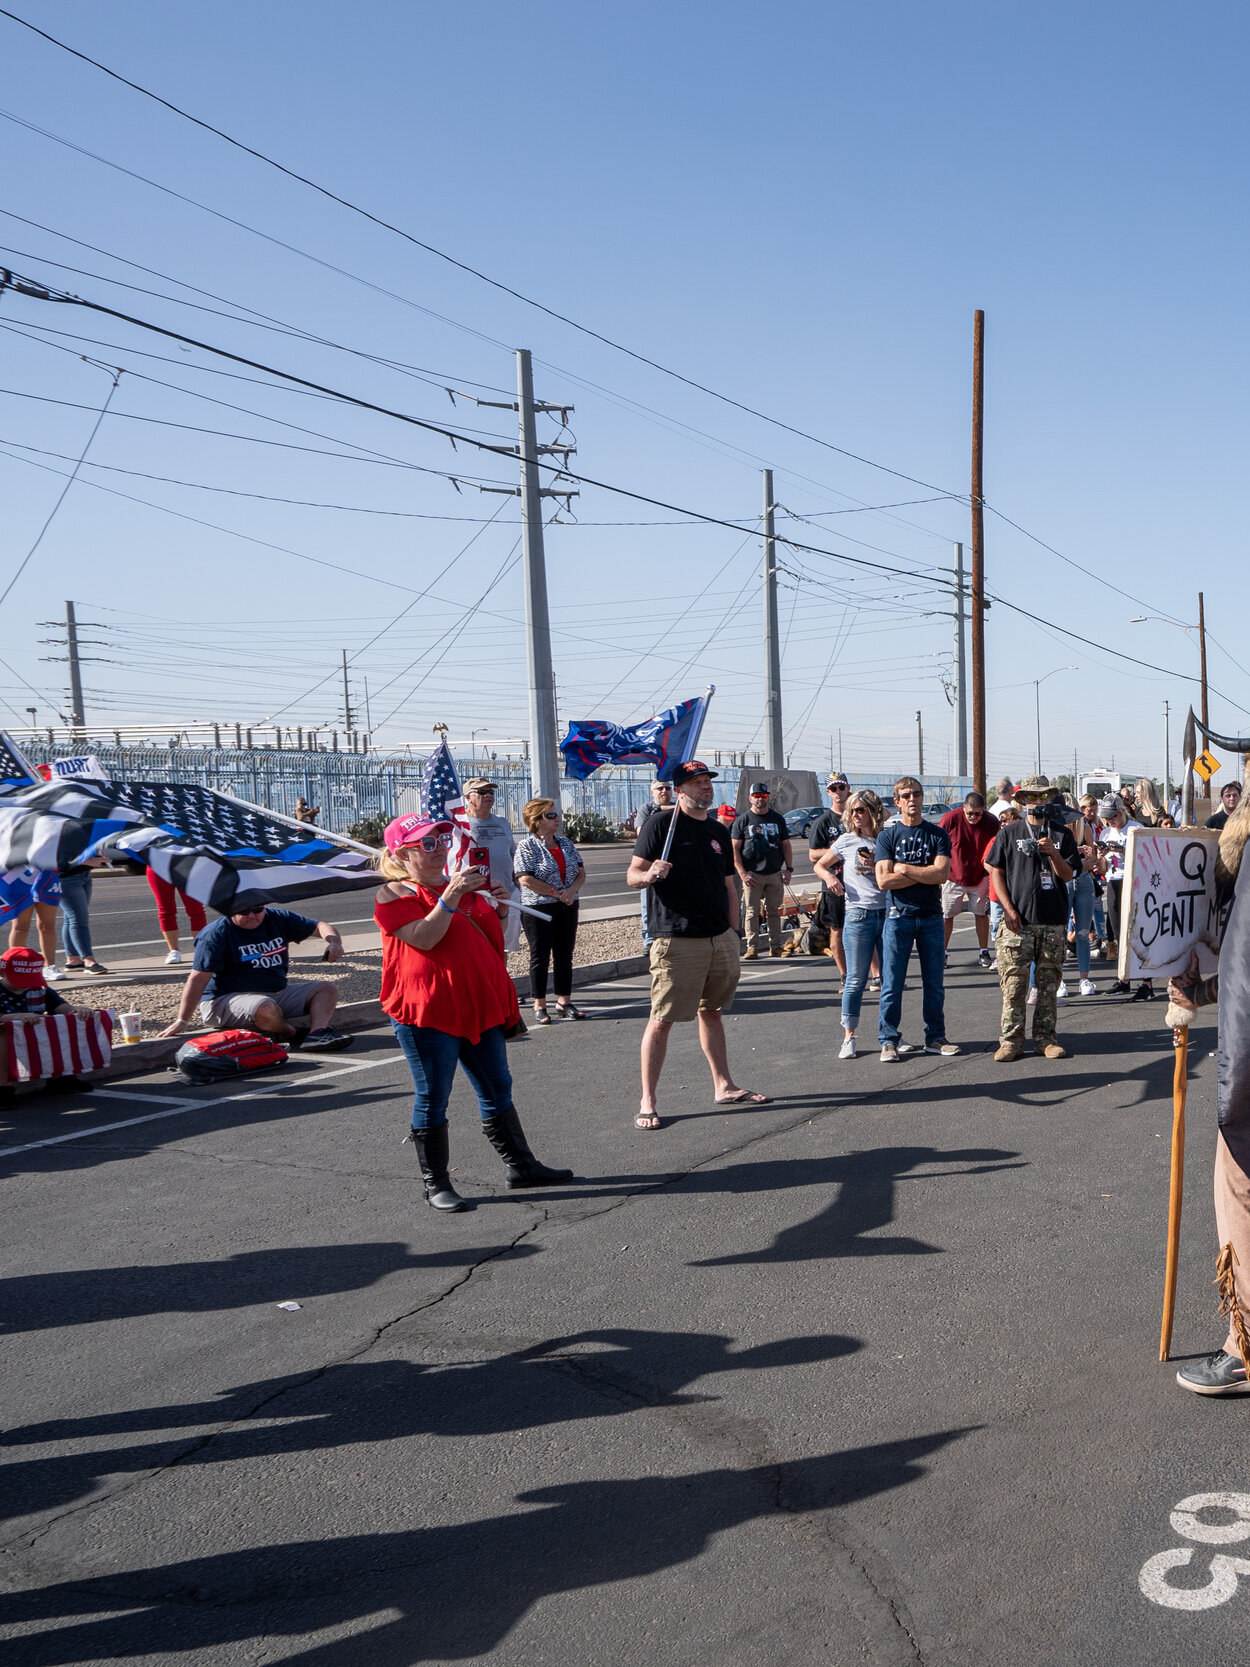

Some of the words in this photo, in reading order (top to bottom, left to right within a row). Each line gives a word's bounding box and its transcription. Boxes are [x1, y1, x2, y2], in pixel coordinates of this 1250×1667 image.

[1179, 841, 1207, 886] Q
[1139, 881, 1206, 947] SENT
[251, 954, 283, 968] 2020
